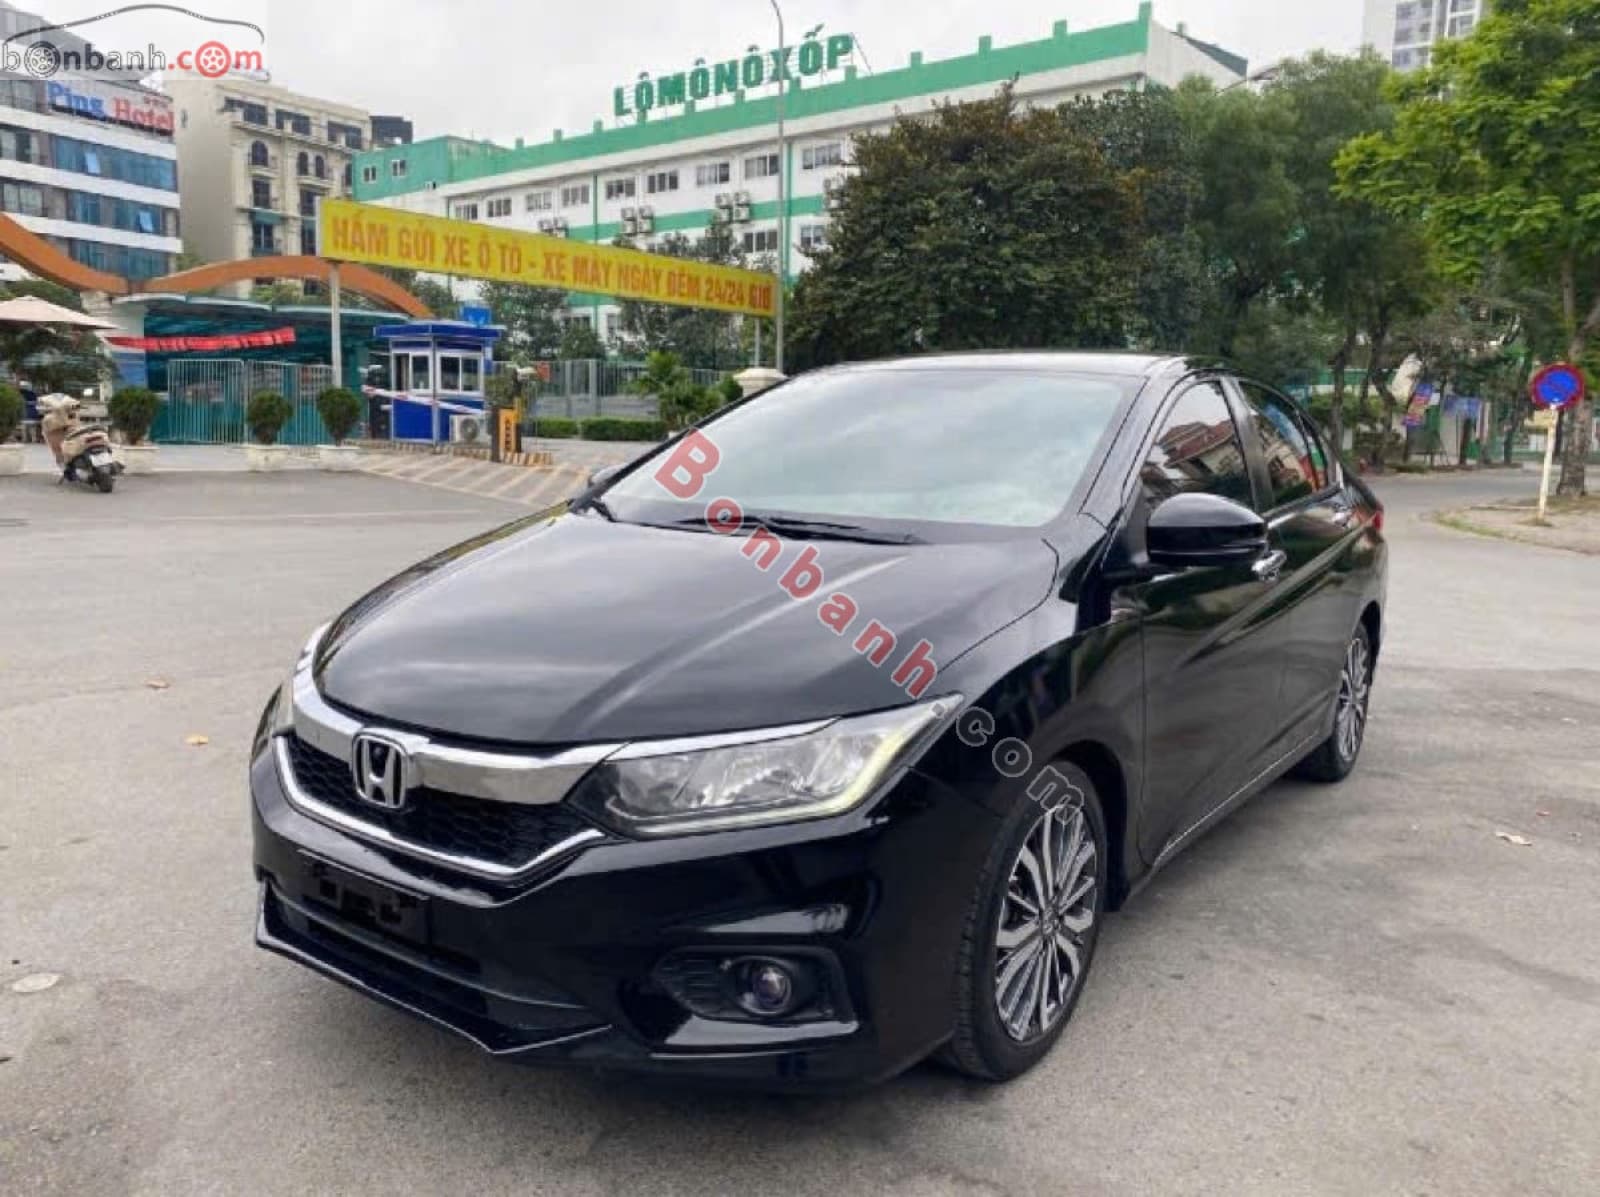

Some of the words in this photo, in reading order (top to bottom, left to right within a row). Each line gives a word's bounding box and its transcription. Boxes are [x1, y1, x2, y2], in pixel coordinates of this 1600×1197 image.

[113, 96, 174, 130] Hotel
[443, 234, 472, 267] XE
[478, 232, 490, 272] Ô
[498, 240, 522, 274] TÔ
[543, 251, 566, 281] XE
[704, 274, 744, 306] 24/24
